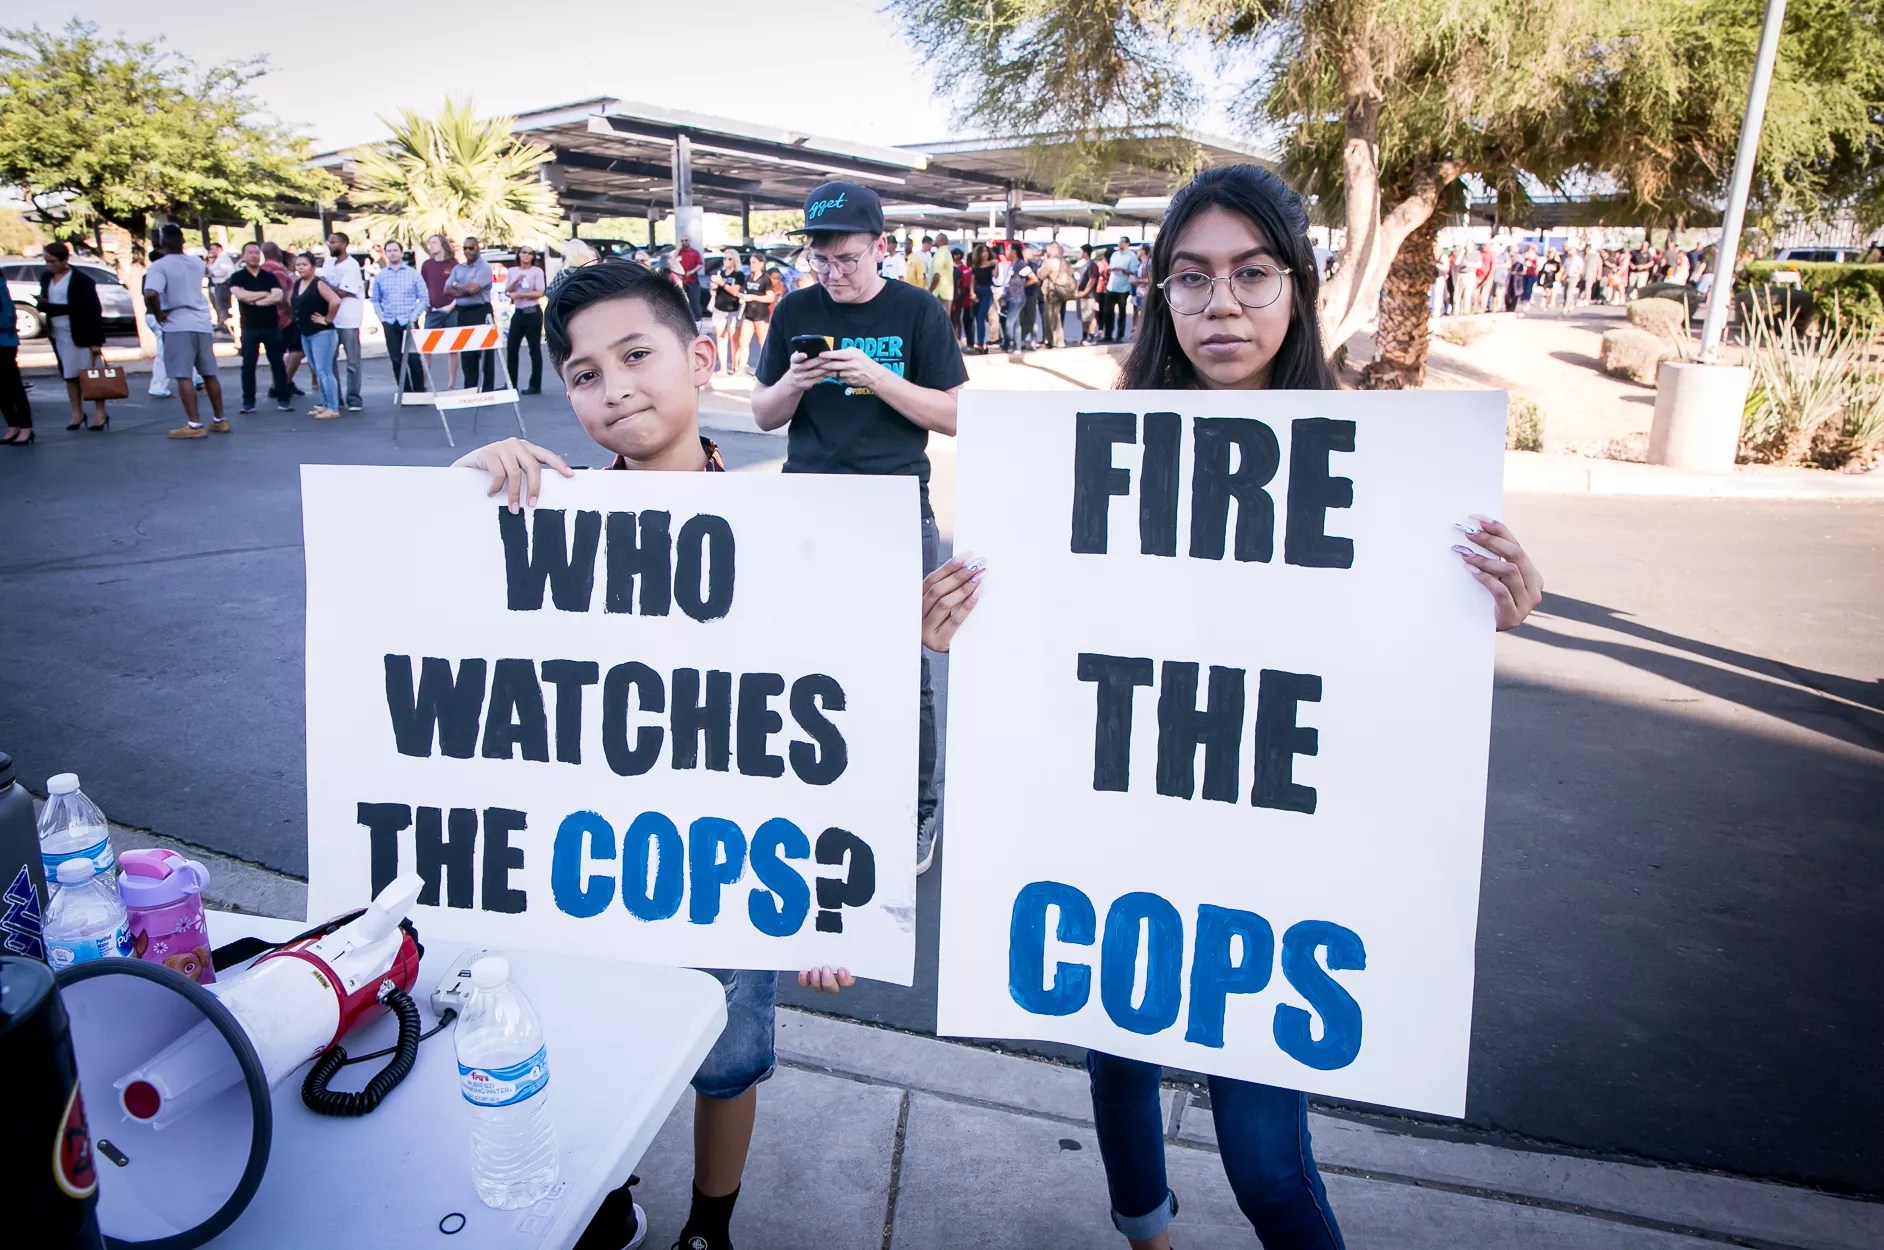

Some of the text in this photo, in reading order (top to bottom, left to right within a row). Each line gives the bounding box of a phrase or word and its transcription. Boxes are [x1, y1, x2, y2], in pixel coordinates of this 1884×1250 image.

[841, 336, 903, 358] PODER
[1071, 411, 1356, 569] FIRE
[498, 505, 736, 623] WHO
[384, 654, 849, 785] WATCHES
[1076, 652, 1322, 815] THE
[357, 801, 876, 938] THE COPS?
[1008, 880, 1367, 1071] COPS
